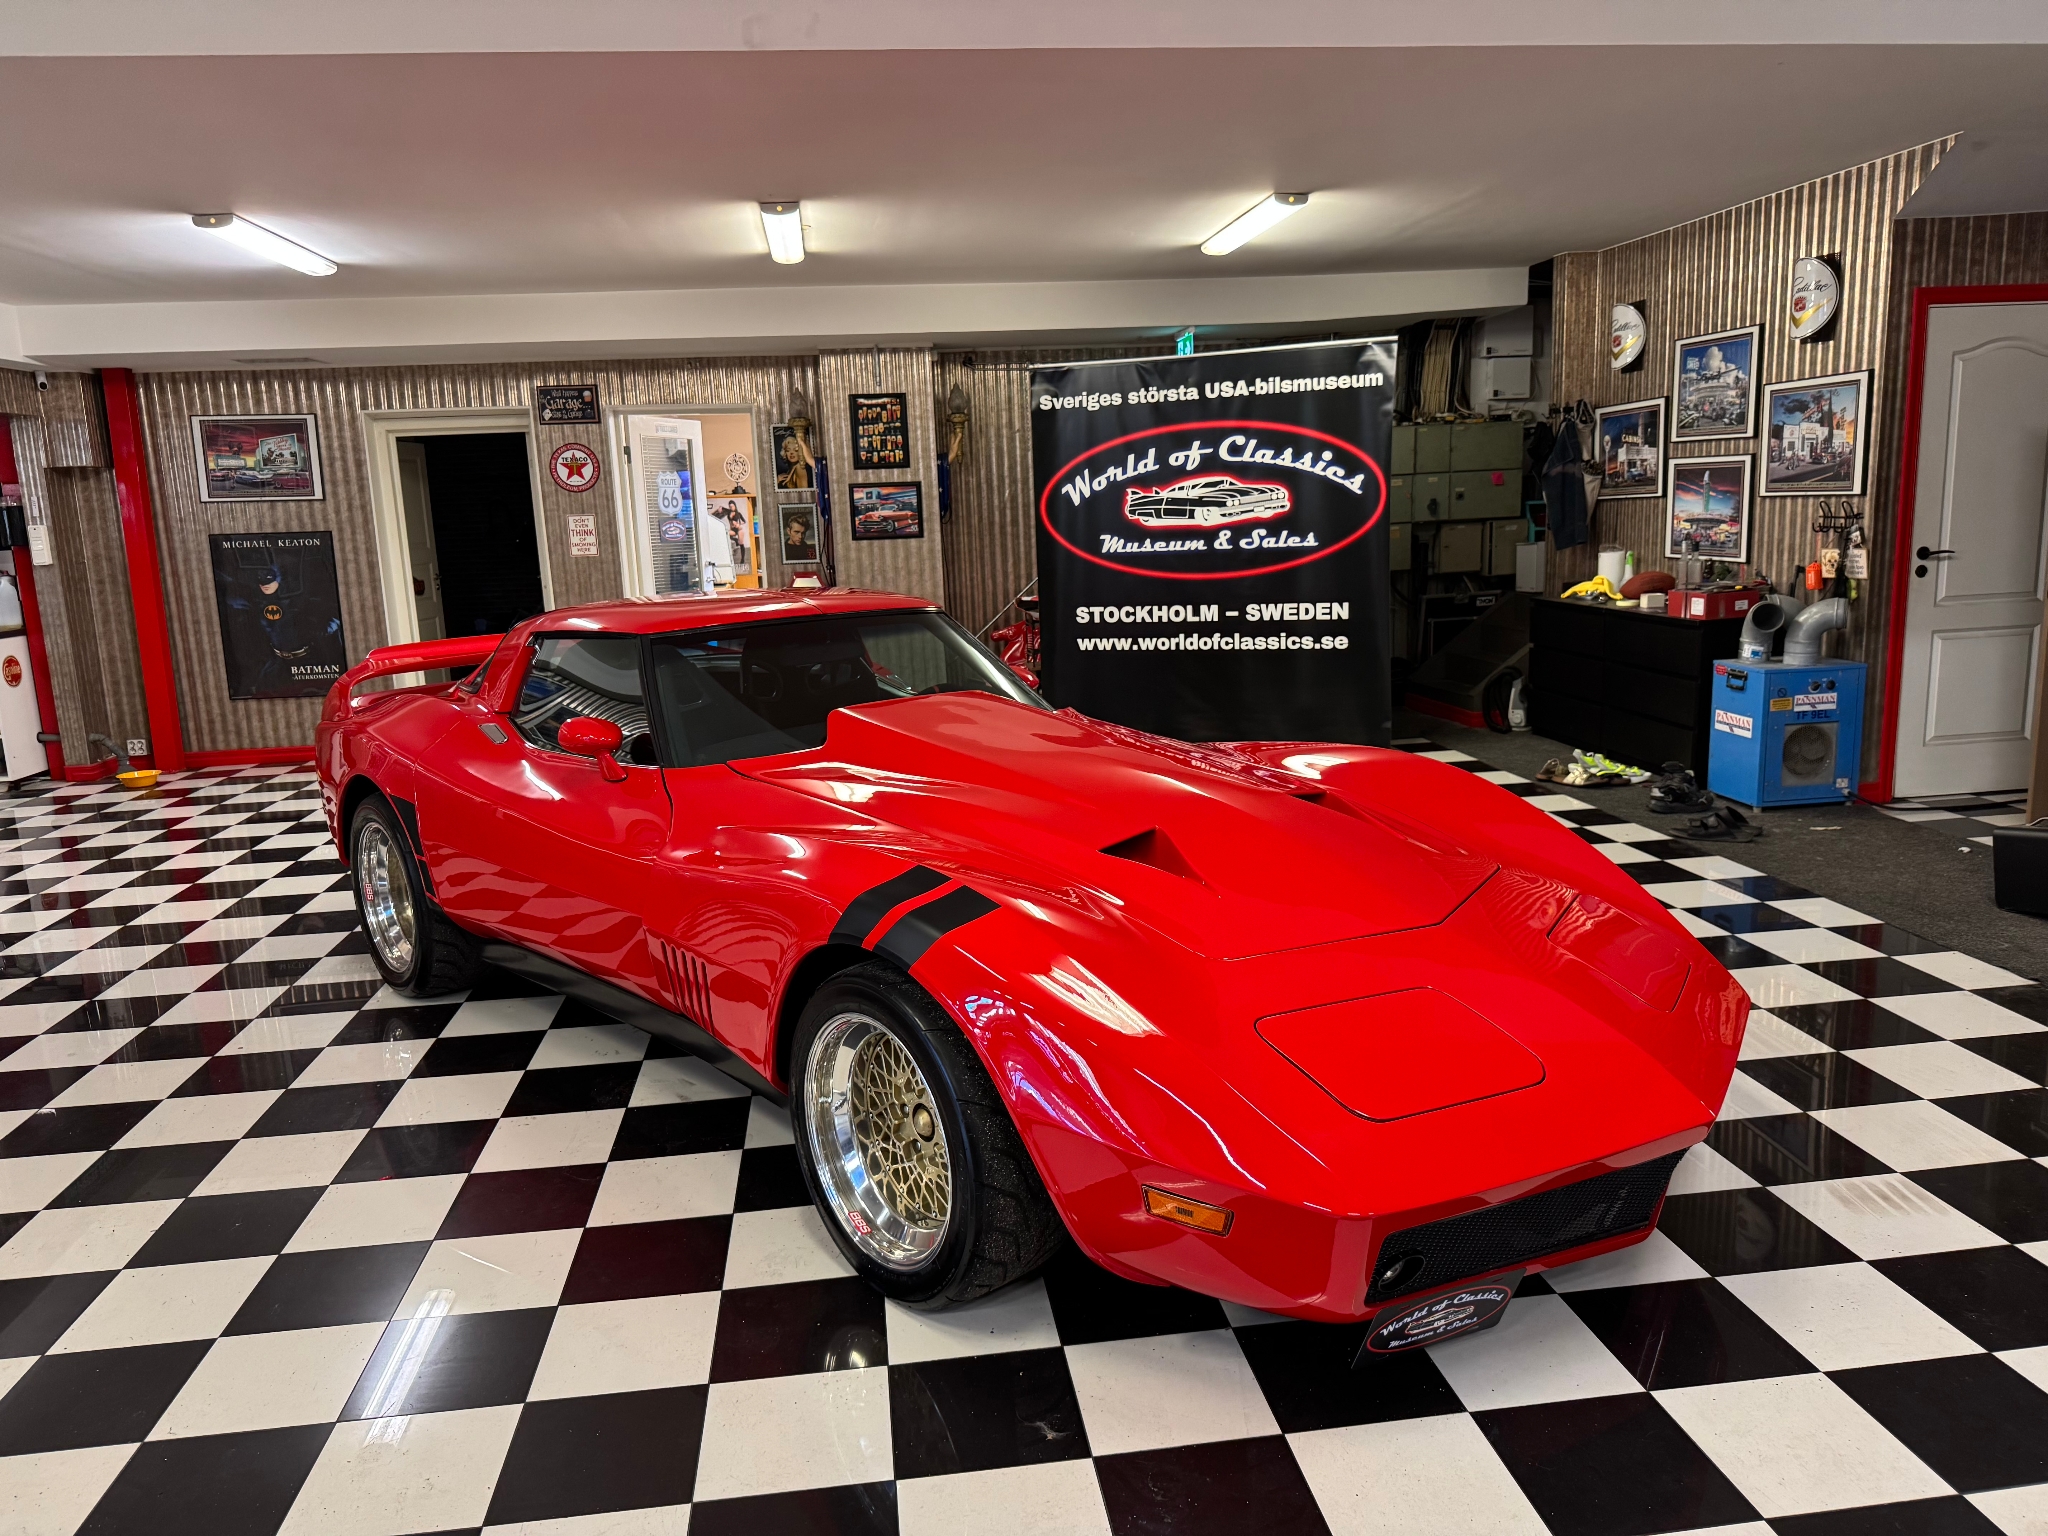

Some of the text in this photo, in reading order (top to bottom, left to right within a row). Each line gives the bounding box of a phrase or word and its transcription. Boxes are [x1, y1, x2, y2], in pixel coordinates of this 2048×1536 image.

[1039, 371, 1384, 412] Sveriges största USA-bilsmuseum
[1061, 435, 1366, 507] World of Classics
[660, 478, 677, 486] ROUTE
[662, 489, 679, 509] 66
[222, 538, 320, 549] MICHAEL KEATON
[571, 529, 594, 537] THINK
[1099, 528, 1319, 554] Museum & Sales
[1075, 604, 1219, 624] STOCKHOLM
[1245, 602, 1350, 622] SWEDEN
[1076, 632, 1350, 651] www.worldofclassics.se
[291, 664, 340, 674] BATMAN
[364, 883, 374, 901] BBS
[850, 1211, 872, 1234] BBS
[1379, 1289, 1505, 1337] World of Classics
[1388, 1316, 1478, 1348] Museum & Sales
